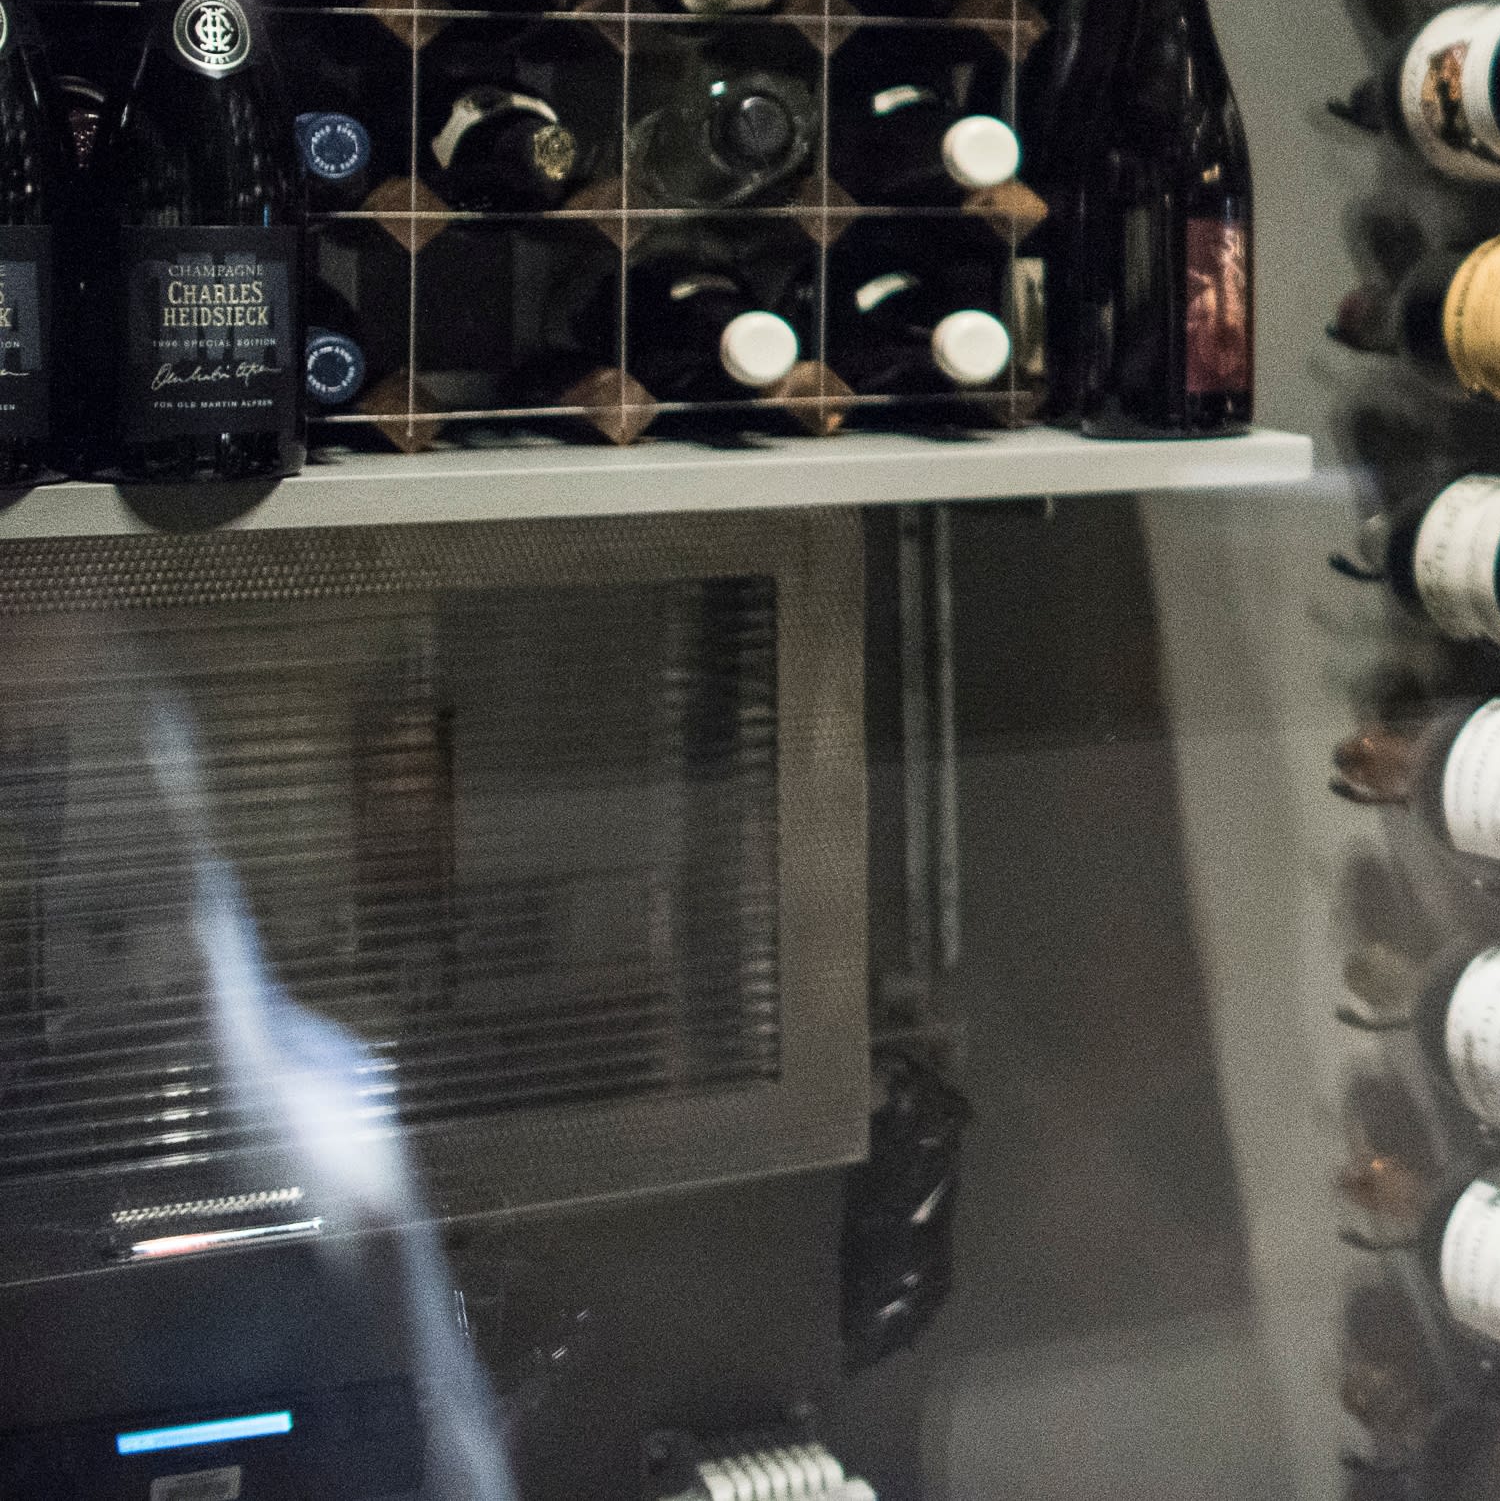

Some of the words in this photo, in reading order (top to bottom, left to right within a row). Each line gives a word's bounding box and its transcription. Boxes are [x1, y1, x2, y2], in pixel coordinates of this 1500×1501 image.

[167, 263, 264, 278] CHAMPAGNE
[167, 281, 264, 305] CHARLES
[162, 306, 269, 327] HEIDSIECK
[183, 338, 232, 348] SPECIAL
[236, 337, 277, 348] EDITION
[200, 400, 238, 408] MARTIN
